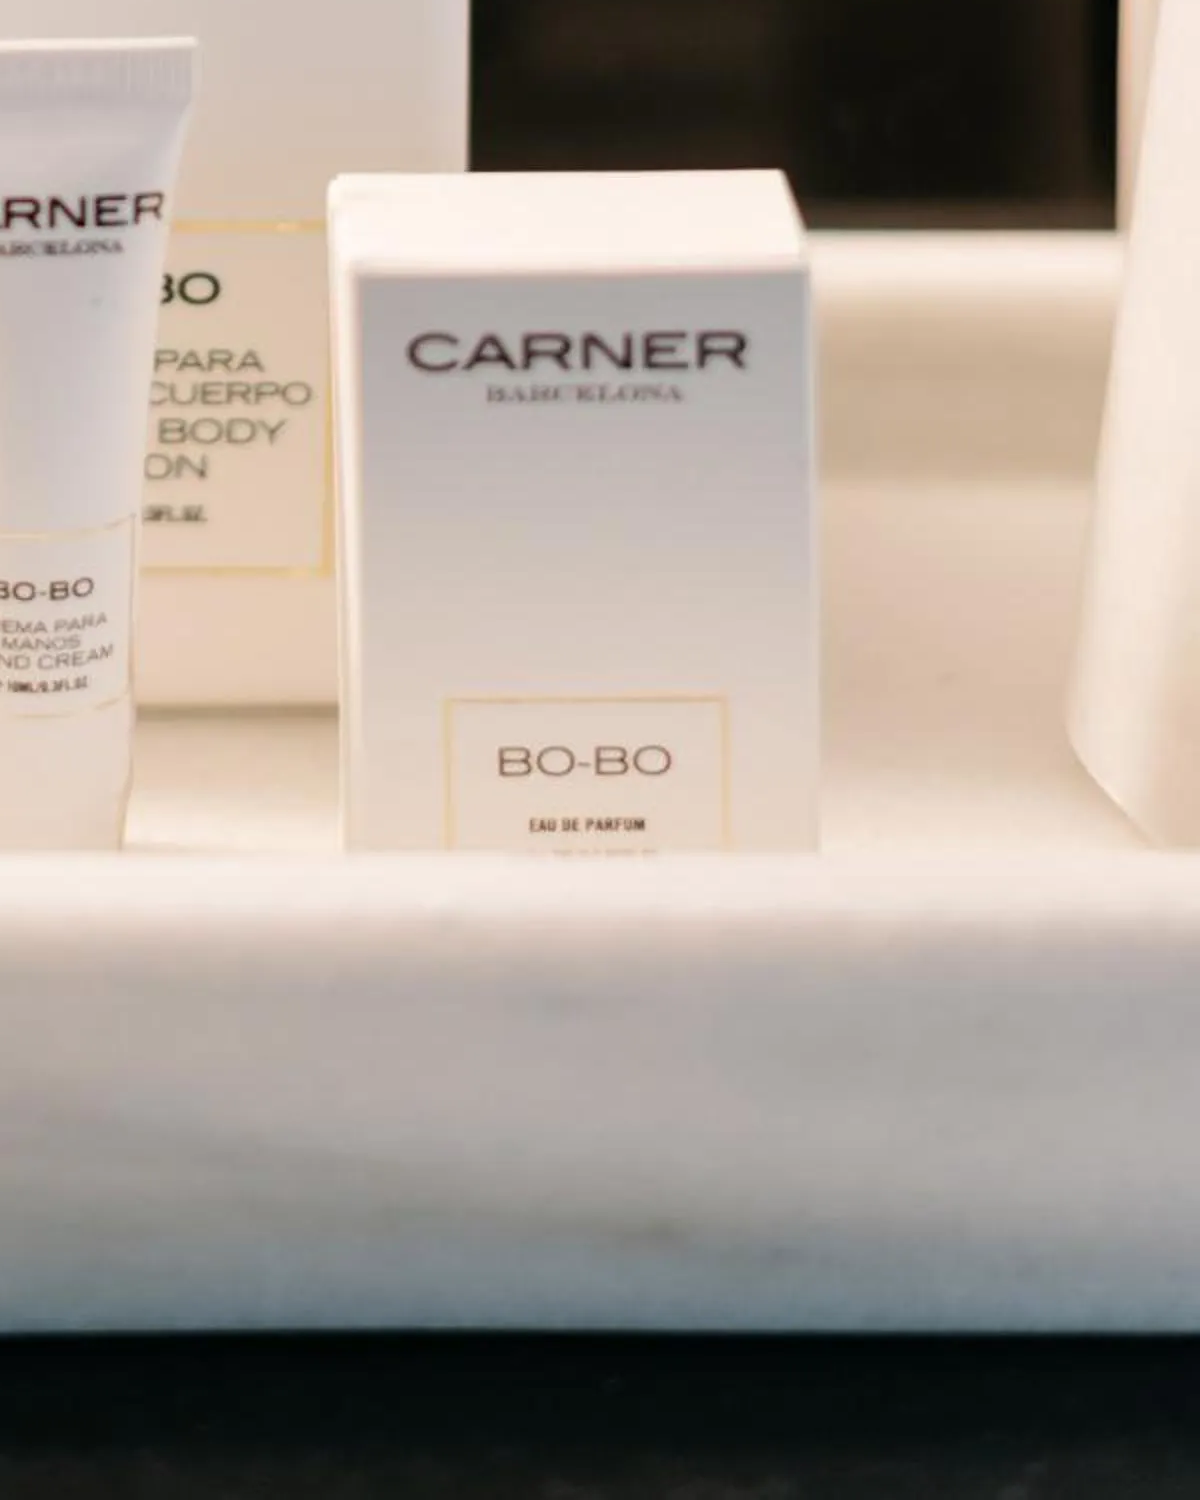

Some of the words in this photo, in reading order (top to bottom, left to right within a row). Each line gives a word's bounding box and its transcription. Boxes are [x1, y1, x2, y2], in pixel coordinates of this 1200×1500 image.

[153, 348, 265, 373] PARA
[406, 330, 748, 373] CARNER
[150, 380, 313, 407] CUERPO
[157, 417, 287, 446] BODY
[53, 612, 108, 632] PARA
[0, 634, 82, 651] MANOS
[36, 643, 114, 670] CREAM
[497, 744, 673, 778] BO-BO
[528, 817, 558, 833] EAU
[561, 817, 580, 833] DE
[584, 817, 647, 833] PARFUM
